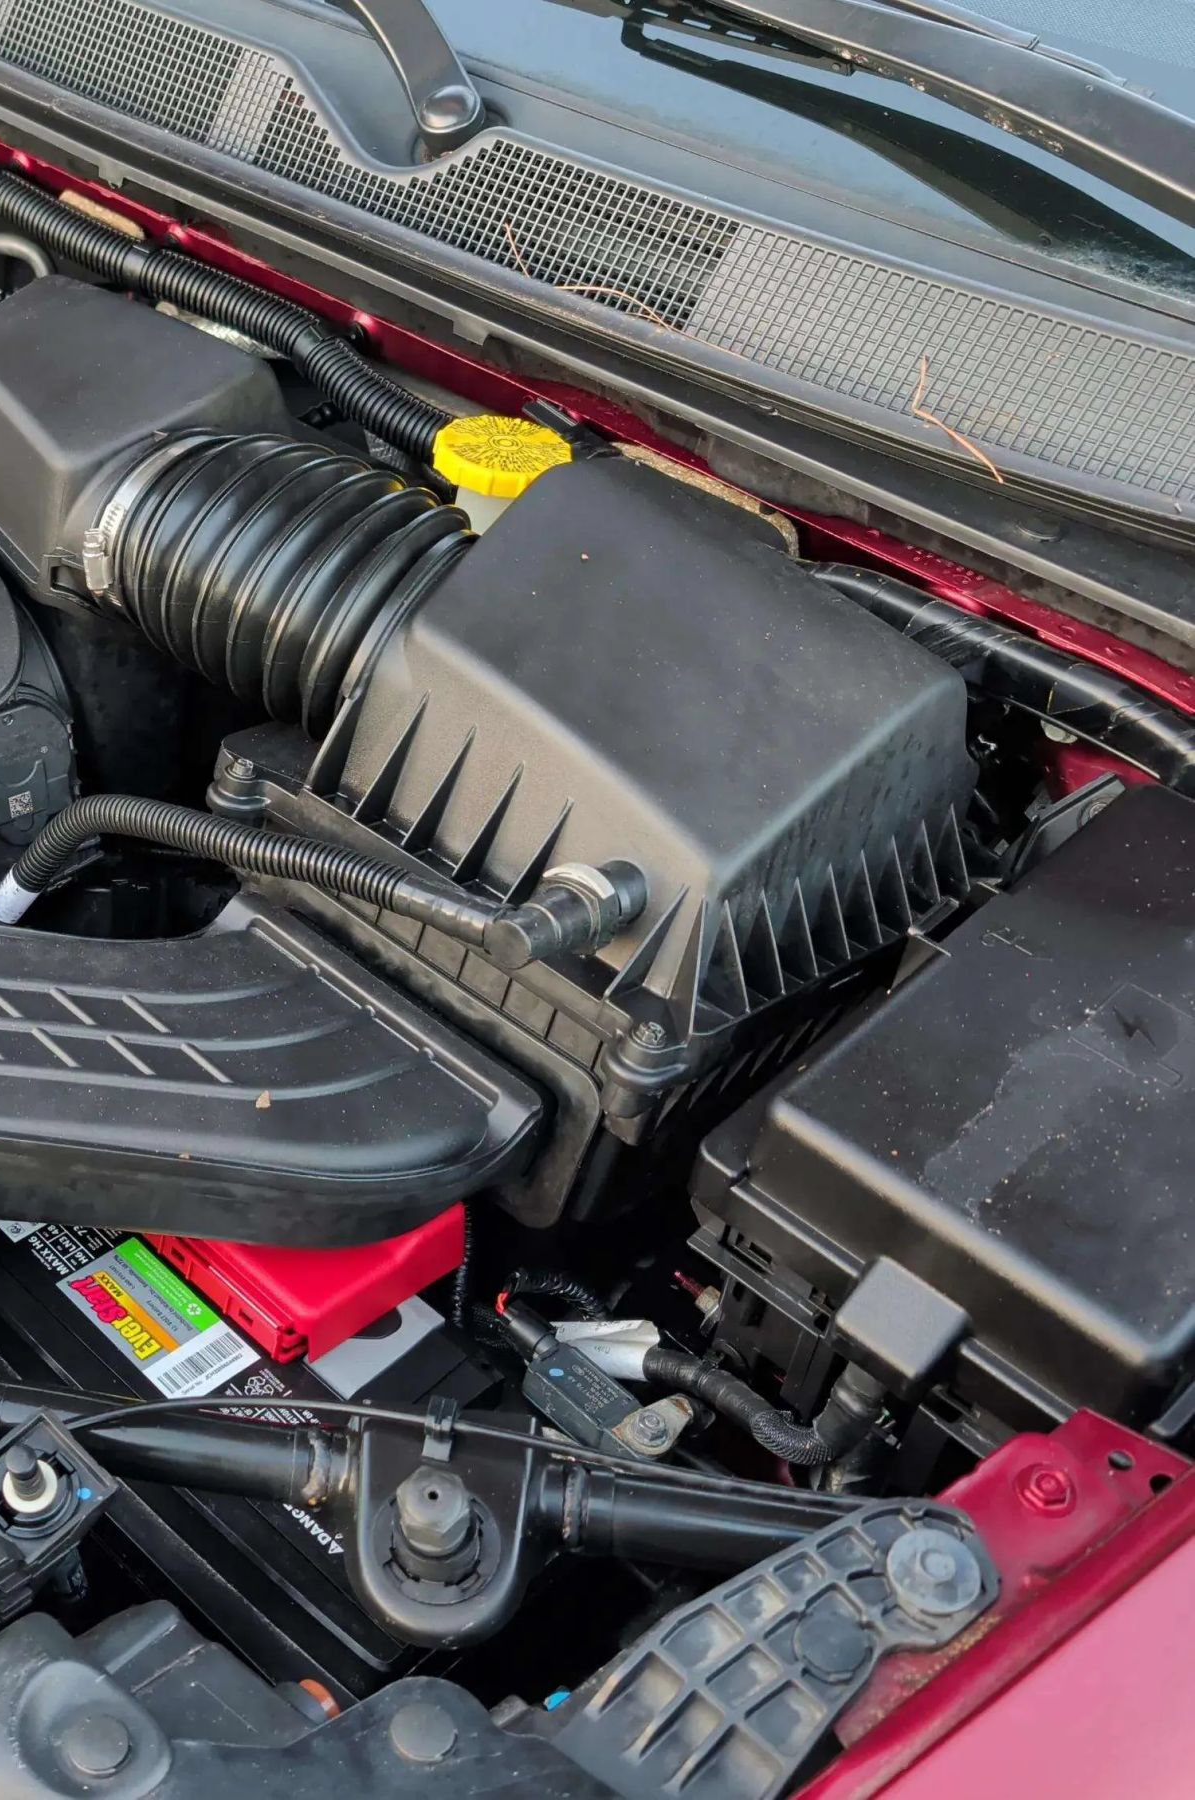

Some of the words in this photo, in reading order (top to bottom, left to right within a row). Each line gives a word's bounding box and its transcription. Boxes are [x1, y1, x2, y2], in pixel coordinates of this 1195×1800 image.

[47, 1223, 60, 1235] 48
[27, 1234, 44, 1249] H6
[58, 1234, 76, 1251] LN3
[38, 1247, 69, 1275] MAXX
[73, 1250, 88, 1264] H6
[97, 1272, 124, 1298] MAXX
[69, 1274, 162, 1361] EverStart
